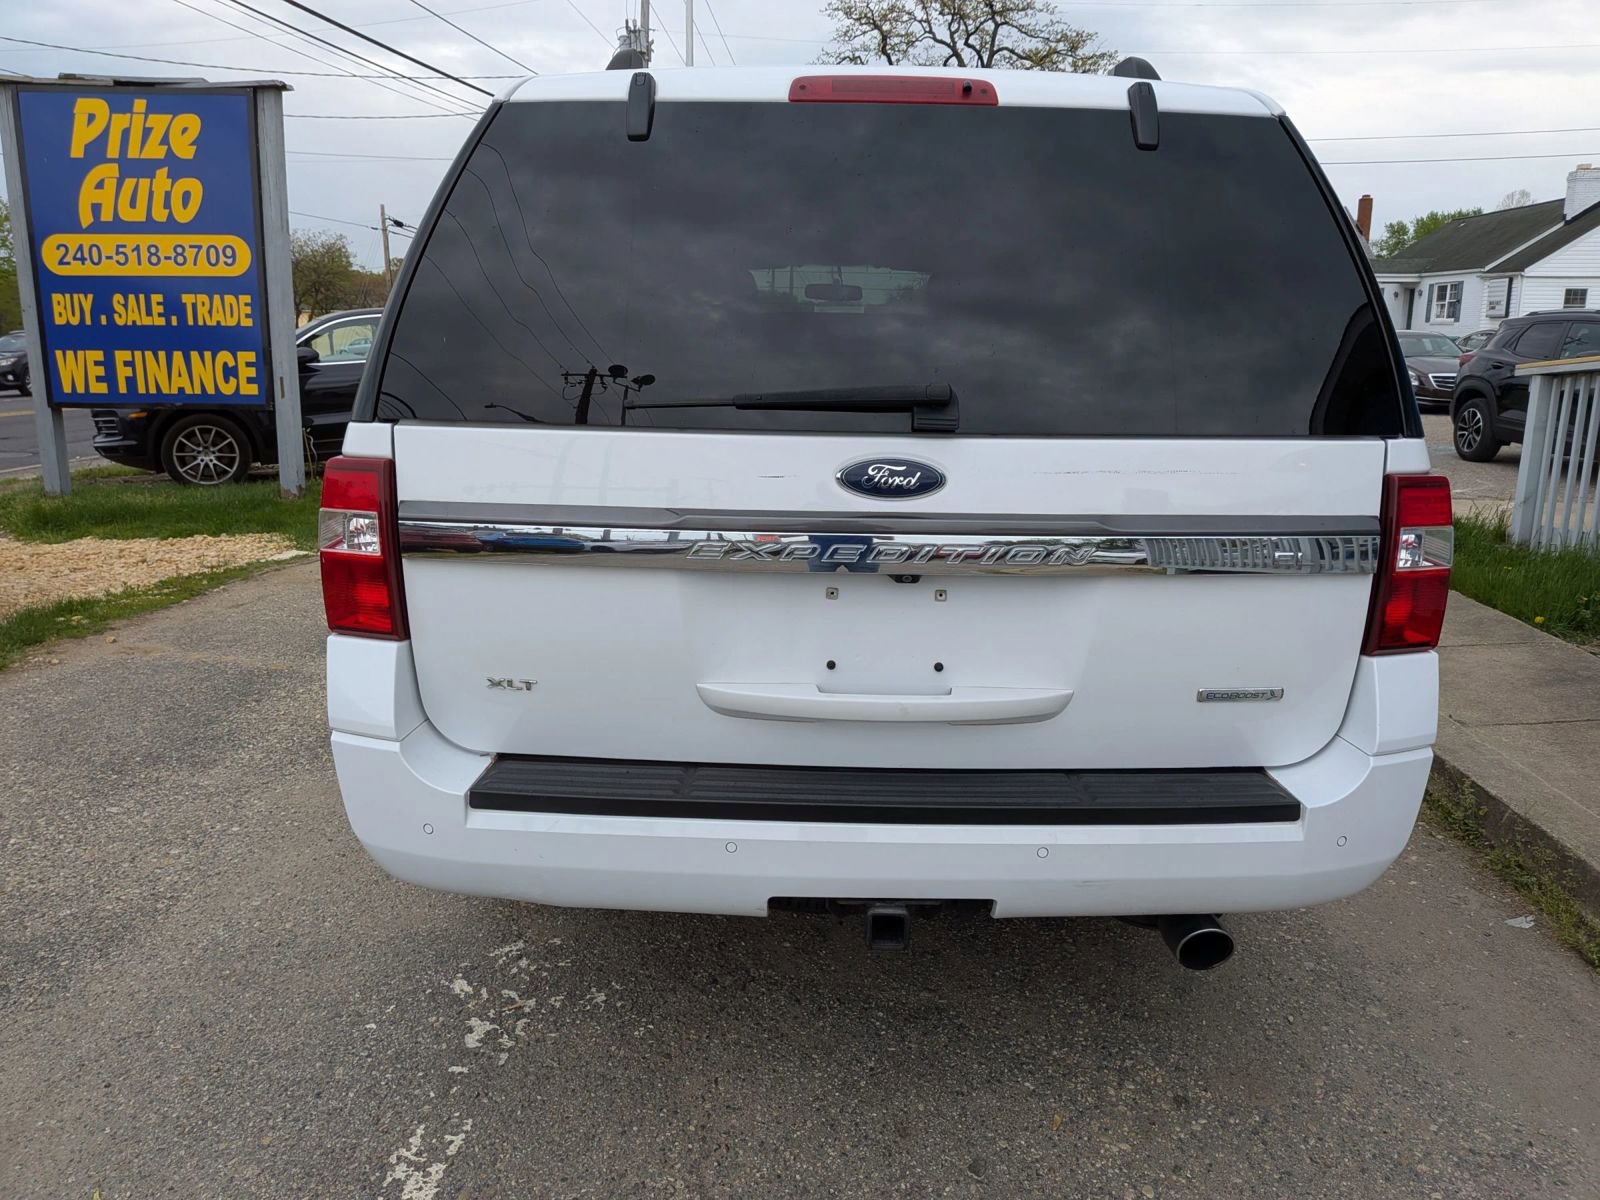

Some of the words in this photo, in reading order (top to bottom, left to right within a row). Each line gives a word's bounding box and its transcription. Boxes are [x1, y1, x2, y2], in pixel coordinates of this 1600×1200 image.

[69, 97, 202, 160] Prize
[77, 162, 204, 230] Auto
[55, 242, 238, 268] 240-518-8709
[51, 292, 94, 326] BUY
[112, 293, 166, 327] SALE
[182, 294, 254, 327] TRADE
[54, 349, 109, 395] WE
[114, 350, 260, 396] FINANCE
[861, 463, 922, 491] Ford
[685, 539, 1099, 567] EXPEDITION
[485, 677, 538, 691] XLT
